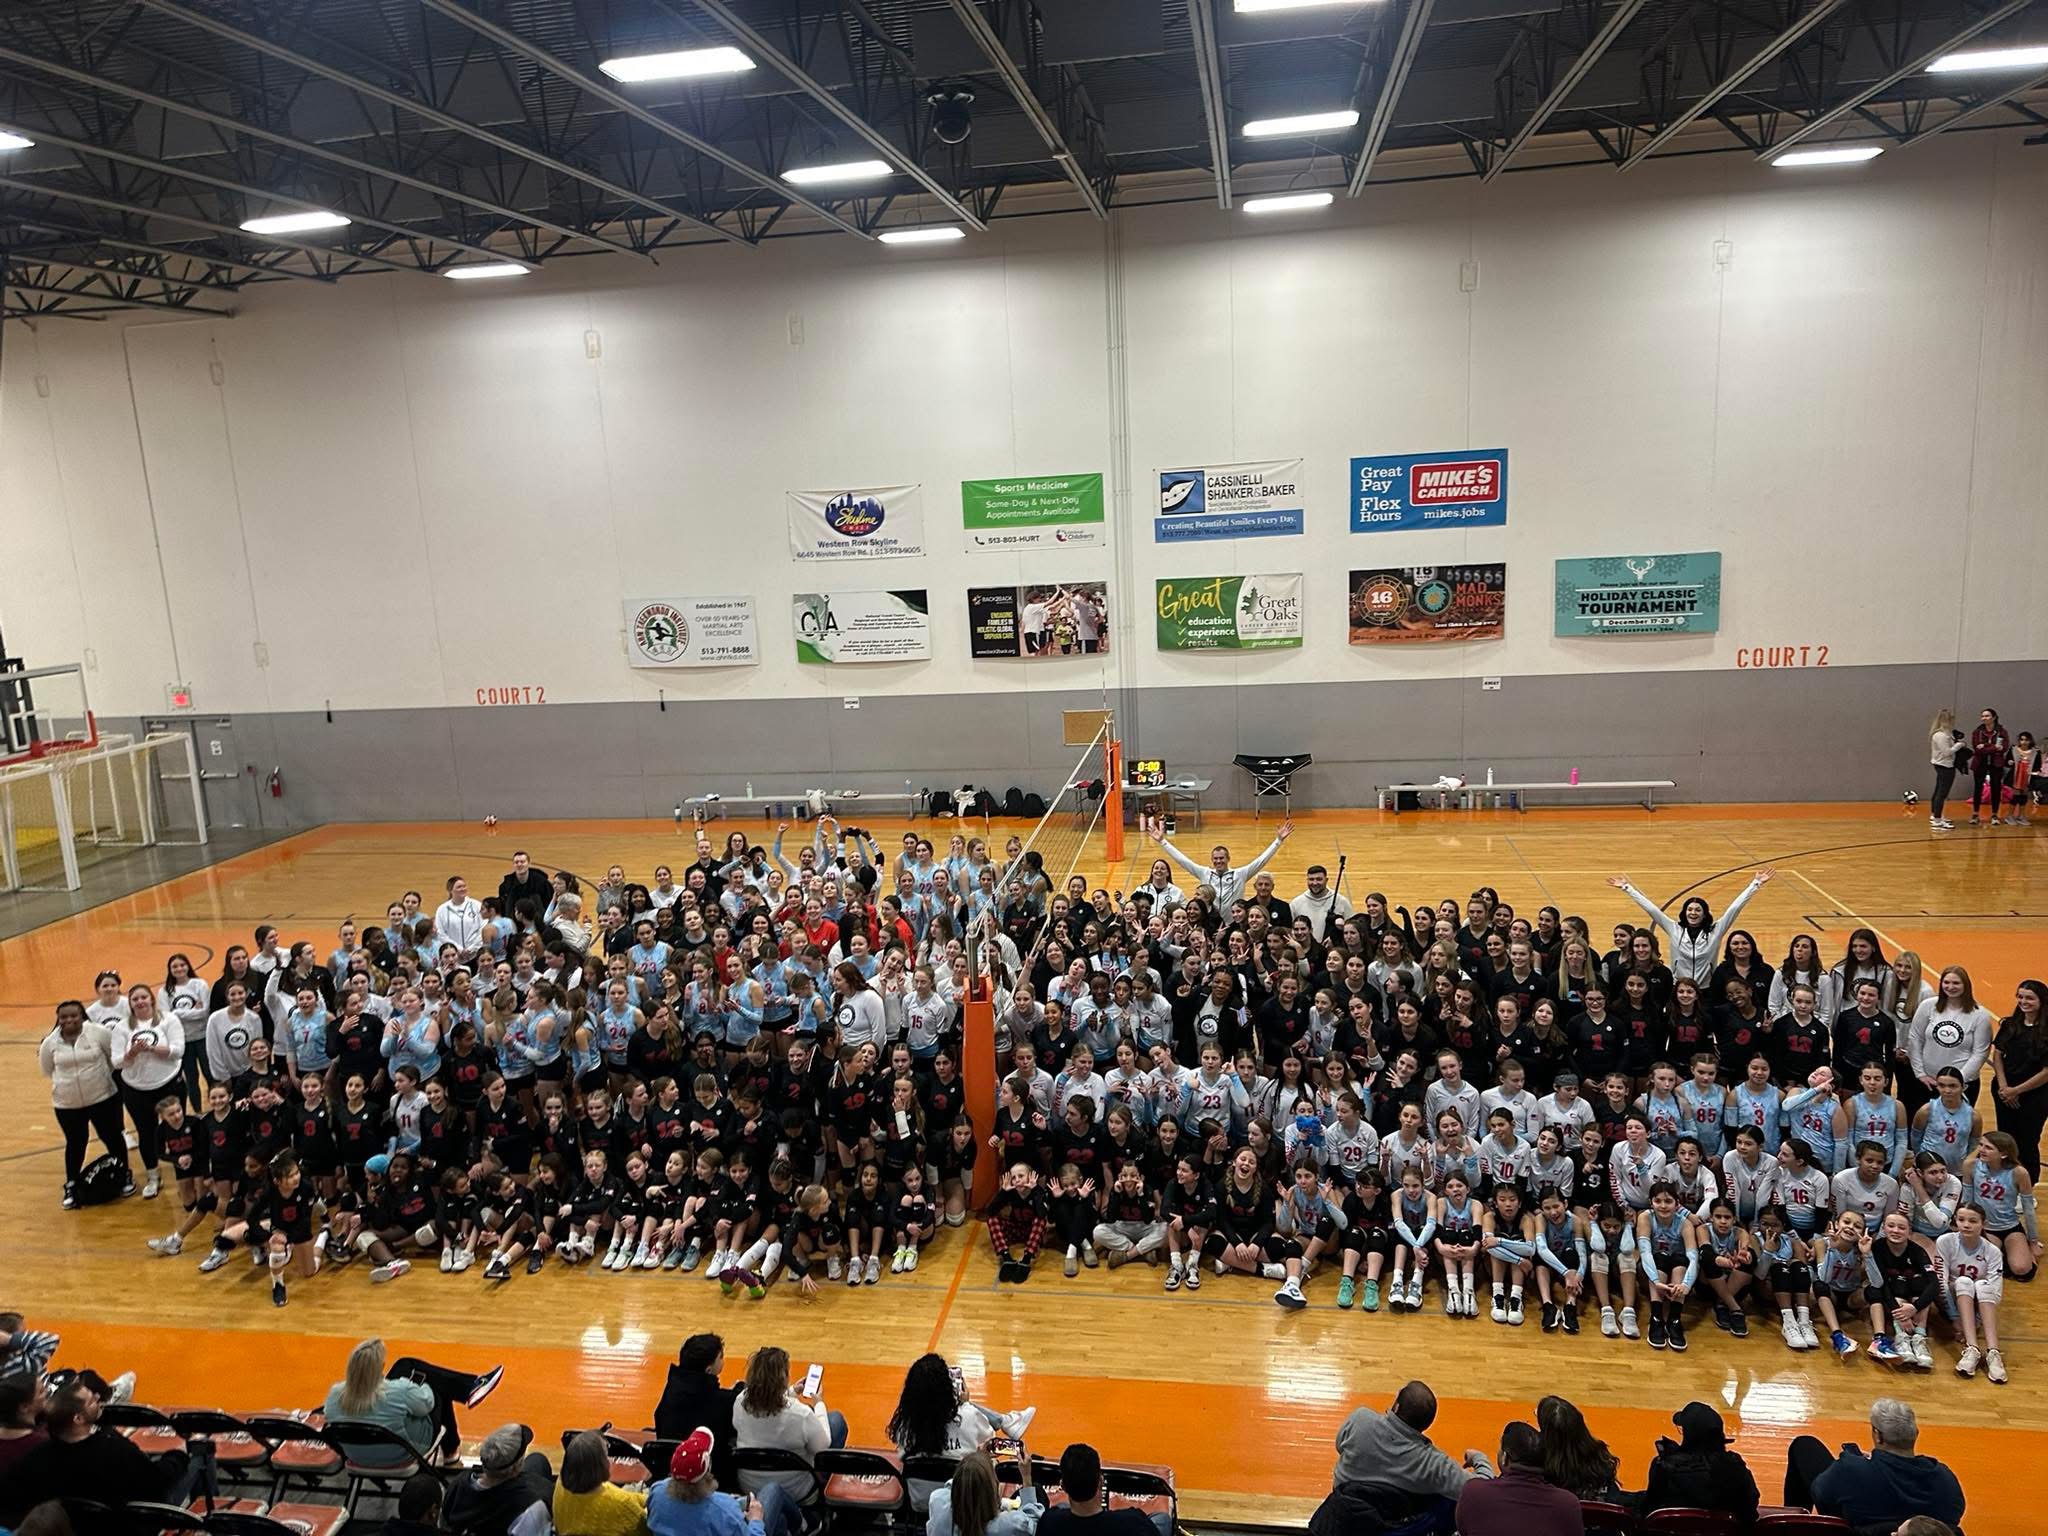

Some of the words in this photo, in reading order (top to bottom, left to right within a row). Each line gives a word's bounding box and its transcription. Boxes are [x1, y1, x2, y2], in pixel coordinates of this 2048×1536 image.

[1360, 466, 1402, 479] Great
[1418, 465, 1493, 487] MIKE'S
[994, 483, 1025, 493] Sports
[1027, 481, 1069, 490] Medicine
[1207, 474, 1263, 488] CASSINELLI
[1360, 479, 1392, 493] Pay
[1417, 485, 1490, 499] CARWASH
[1031, 498, 1037, 506] &
[1040, 497, 1080, 506] Next-Day
[1360, 496, 1402, 511] Flex
[835, 508, 878, 527] Skyline
[986, 510, 1040, 519] Appointments
[1042, 507, 1080, 516] Available
[1360, 511, 1401, 522] Hours
[1424, 507, 1485, 519] mikes.jobs
[1161, 521, 1194, 531] Creating
[1195, 519, 1229, 528] Beautiful
[1230, 516, 1256, 525] Smiles
[1257, 516, 1278, 526] Every
[817, 540, 849, 548] Western
[851, 539, 868, 547] Row
[870, 538, 897, 547] Skyline
[988, 535, 1040, 544] 513-803-HURT
[1456, 582, 1487, 594] MAD
[1160, 578, 1239, 620] Great
[1259, 595, 1296, 608] Great
[1371, 591, 1393, 604] 16
[1456, 594, 1501, 607] MONKS
[1581, 592, 1638, 602] HOLIDAY
[1641, 589, 1696, 600] CLASSIC
[1578, 600, 1697, 614] TOURNAMENT
[1188, 617, 1232, 625] education
[1264, 608, 1298, 621] Oaks
[1188, 627, 1235, 638] experience
[1188, 638, 1218, 646] results
[1737, 646, 1811, 668] COURT
[1817, 646, 1829, 666] 2
[476, 686, 531, 705] COURT
[536, 686, 546, 704] 2
[765, 983, 773, 996] 3
[911, 1014, 923, 1030] 15
[303, 1031, 309, 1044] 7
[609, 1027, 627, 1040] 24
[1203, 1095, 1221, 1109] 23
[400, 1114, 411, 1128] 11
[1696, 1109, 1716, 1123] 85
[1755, 1110, 1764, 1125] 3
[1803, 1114, 1823, 1131] 28
[1867, 1122, 1887, 1136] 17
[1945, 1127, 1956, 1143] 8
[1343, 1146, 1362, 1161] 29
[1499, 1161, 1514, 1179] 10
[1790, 1188, 1809, 1204] 16
[1980, 1183, 2005, 1201] 22
[1957, 1262, 1979, 1279] 13
